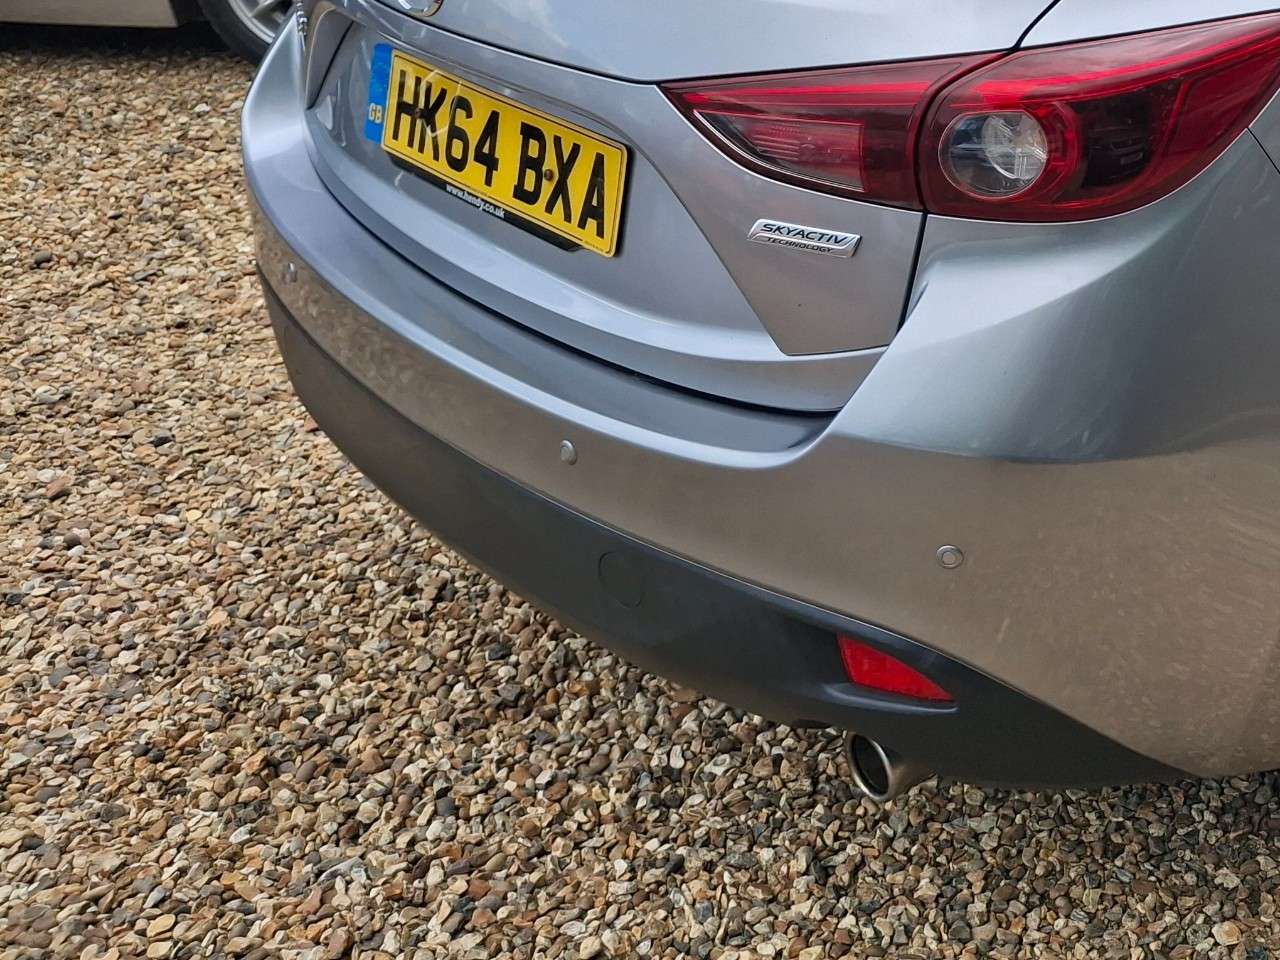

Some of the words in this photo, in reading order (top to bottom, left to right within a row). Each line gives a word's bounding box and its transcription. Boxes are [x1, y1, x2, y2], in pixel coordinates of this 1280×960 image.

[368, 102, 383, 125] GB
[391, 69, 501, 188] HK64
[511, 120, 606, 240] BXA
[761, 223, 849, 244] SKYACTIV
[767, 237, 834, 253] TECHNOLOGY
